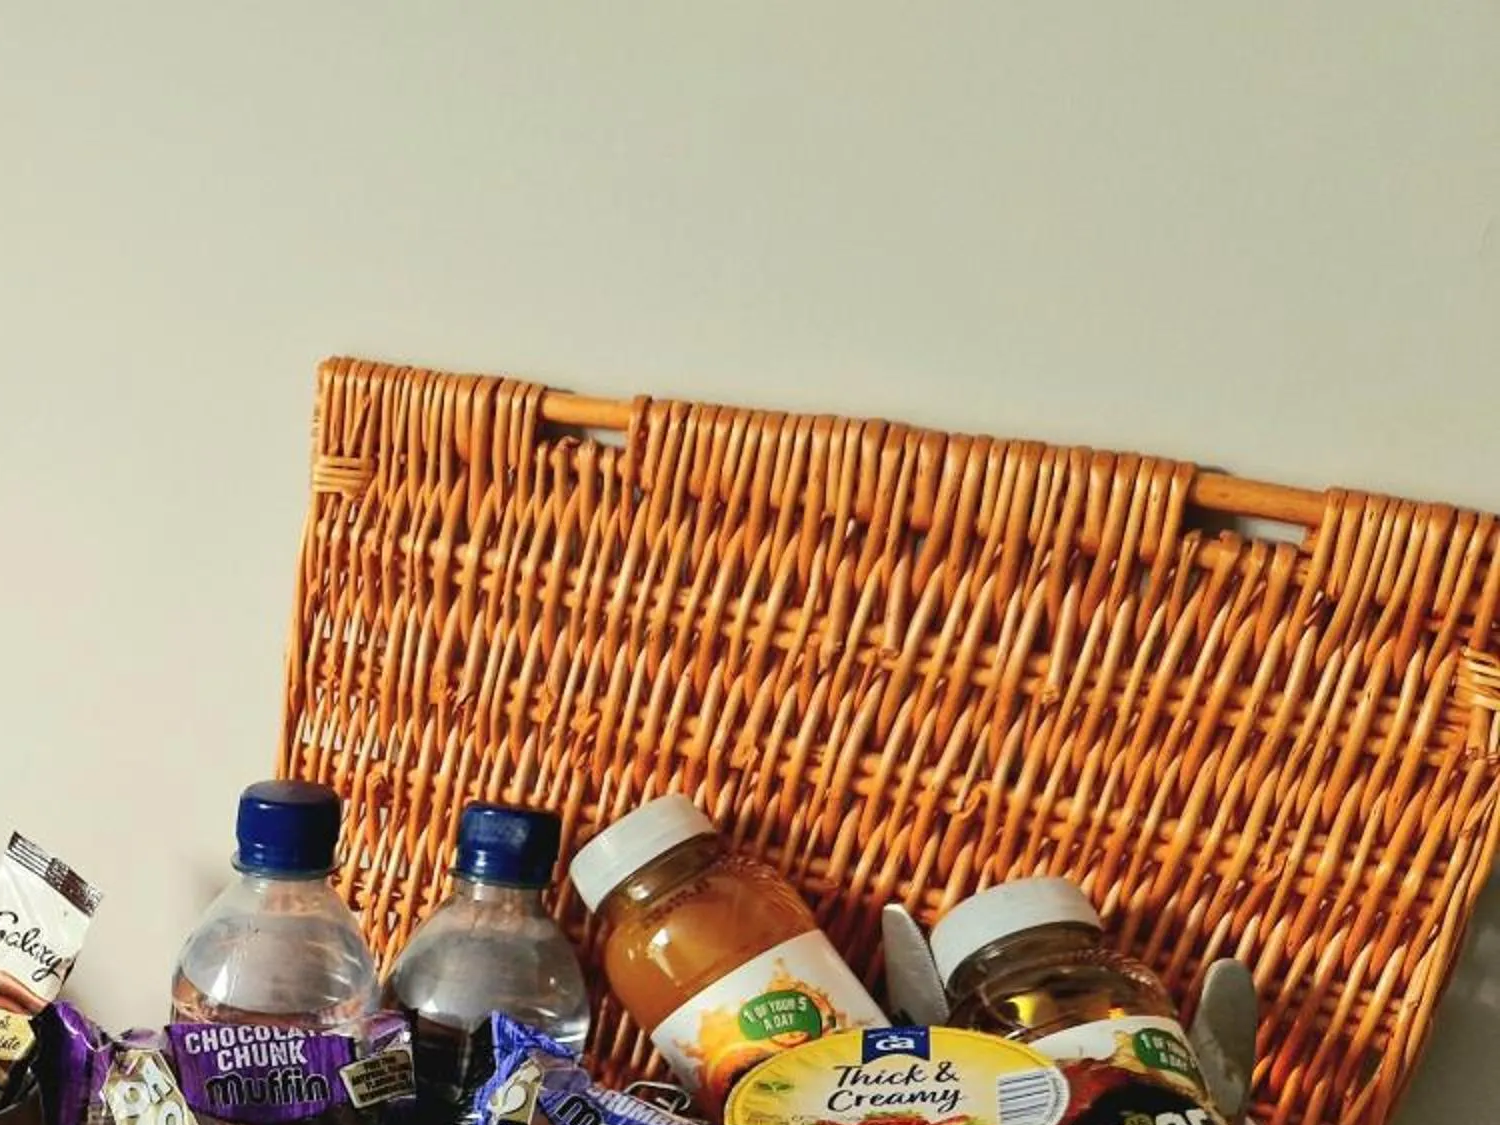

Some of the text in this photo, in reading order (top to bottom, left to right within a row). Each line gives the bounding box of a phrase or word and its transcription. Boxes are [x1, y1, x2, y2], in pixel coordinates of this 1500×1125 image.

[217, 1039, 308, 1072] CHUNK
[205, 1067, 330, 1107] Muffin
[833, 1061, 961, 1090] Thick &
[827, 1087, 963, 1113] Creamy
